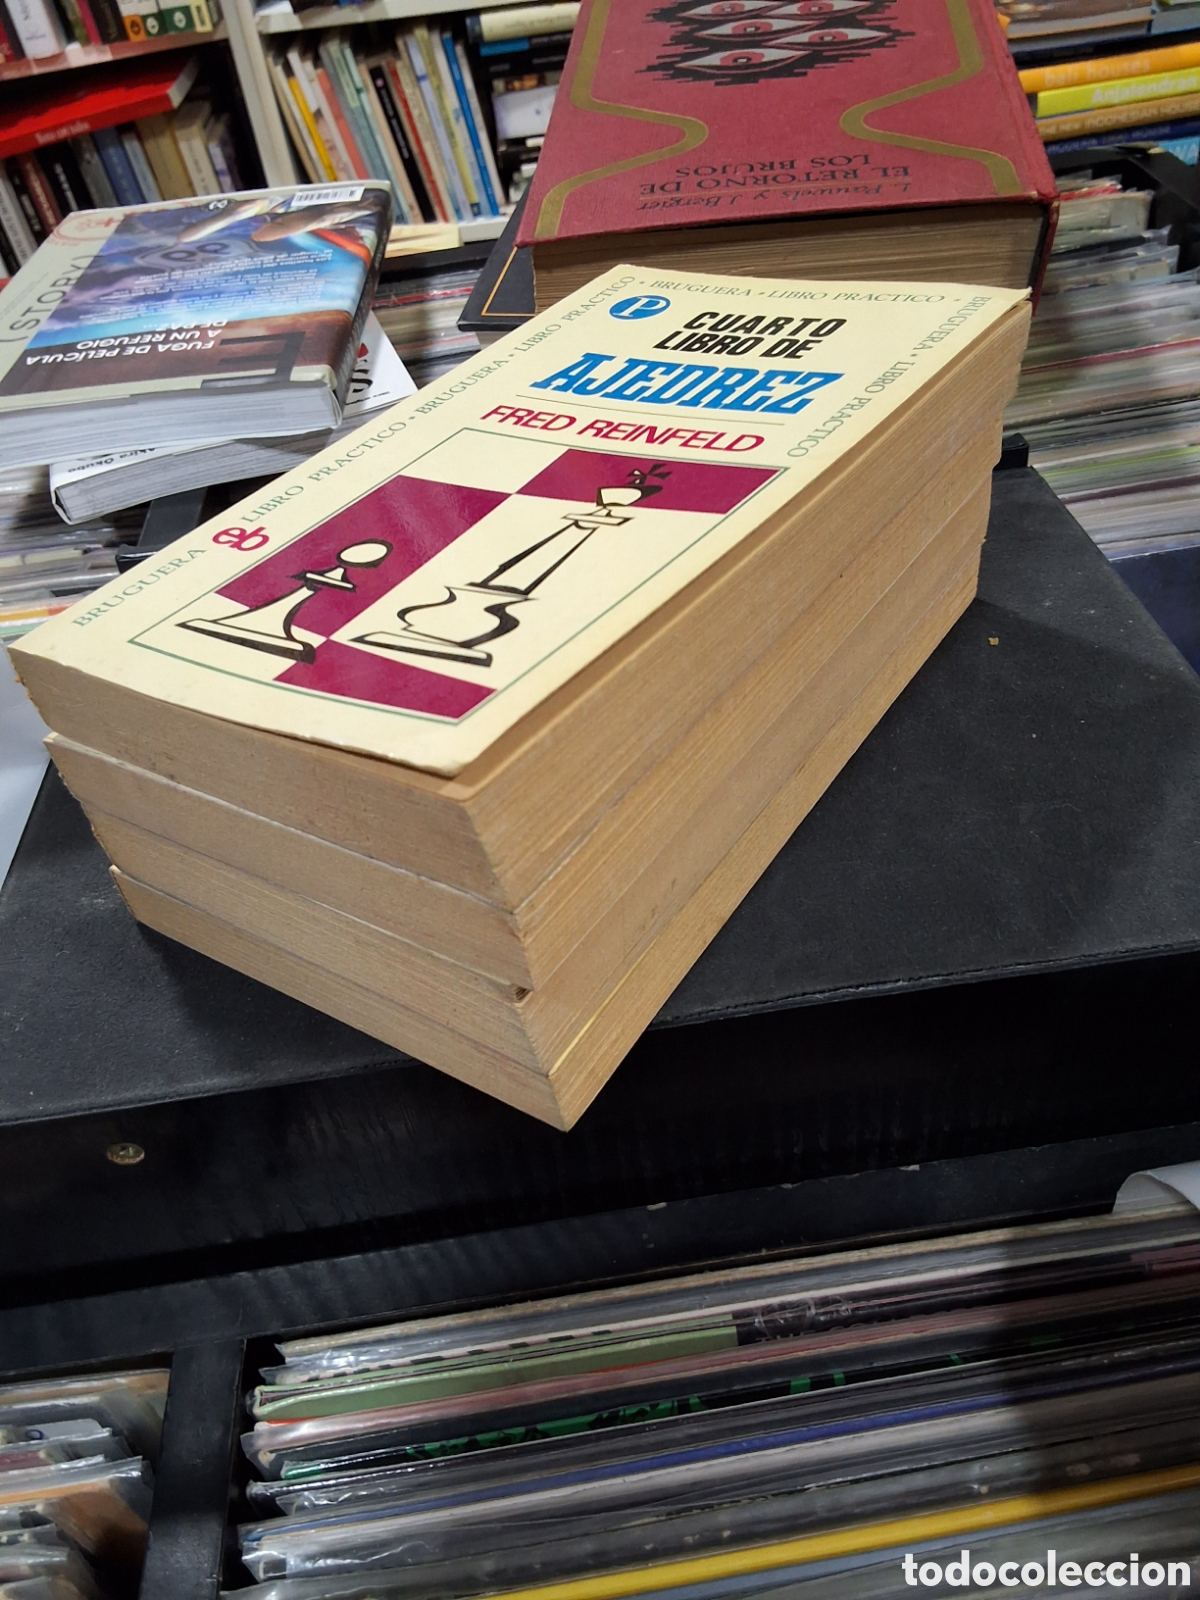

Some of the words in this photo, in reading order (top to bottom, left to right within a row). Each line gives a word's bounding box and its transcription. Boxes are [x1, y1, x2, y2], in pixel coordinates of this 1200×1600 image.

[675, 159, 796, 178] BRUJOS
[810, 154, 871, 168] LOS
[697, 168, 859, 190] RETORNO
[873, 166, 910, 178] EL
[640, 181, 683, 195] DE
[753, 189, 771, 200] y
[782, 184, 882, 201] Pauwels
[636, 197, 719, 212] Bergier
[650, 280, 752, 298] BRUGUERA
[767, 290, 828, 301] LIBRO
[833, 293, 946, 304] PRACTICO
[683, 311, 848, 338] CUARTO
[913, 296, 993, 352] BRUGUERA
[76, 333, 164, 350] REFUGIO
[170, 331, 202, 341] UN
[208, 329, 223, 339] A
[122, 344, 152, 356] DE
[158, 340, 215, 353] FUGA
[652, 330, 765, 358] LIBRO
[759, 337, 824, 360] DE
[26, 348, 120, 366] PELÍCULA
[529, 352, 845, 416] AJEDREZ
[865, 361, 916, 394] LIBRO
[480, 404, 577, 432] FRED
[576, 419, 766, 453] REINFELD
[786, 396, 873, 458] PRACTICO
[72, 549, 208, 627] BRUGUERA
[241, 485, 304, 523] LIBRO
[307, 421, 407, 482] PRACTICO
[415, 357, 510, 416] BRUGUERA
[513, 323, 562, 352] LIBRO
[561, 275, 636, 322] PRACTICO
[67, 457, 115, 473] Okubo
